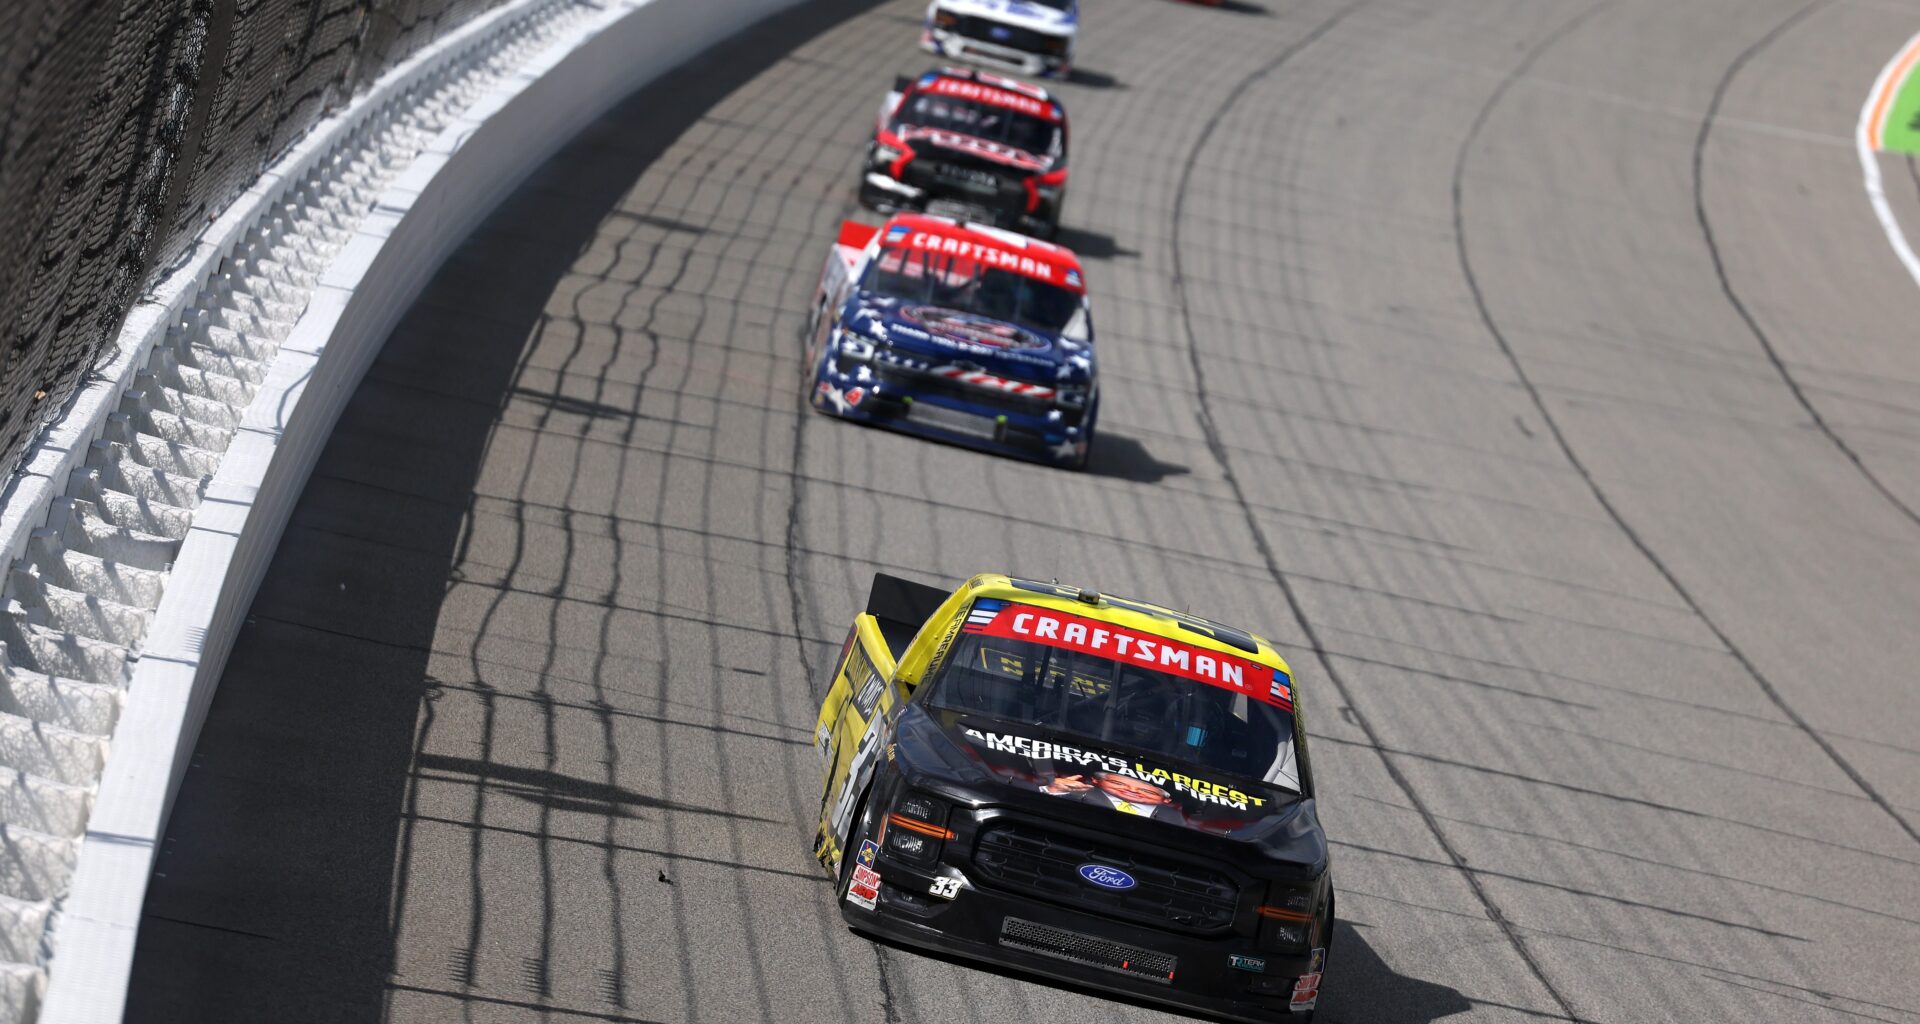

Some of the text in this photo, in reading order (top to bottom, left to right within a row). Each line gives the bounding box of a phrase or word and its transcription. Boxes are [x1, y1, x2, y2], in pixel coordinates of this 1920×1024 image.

[912, 232, 1052, 279] CRAFTSMAN
[1012, 613, 1244, 687] CRAFTSMAN
[965, 728, 1267, 807] AMERICA'S LARGEST
[986, 741, 1248, 811] INJURY LAW FIRM
[928, 876, 964, 900] 33
[1088, 867, 1126, 886] Ford
[1243, 958, 1265, 968] TEAM
